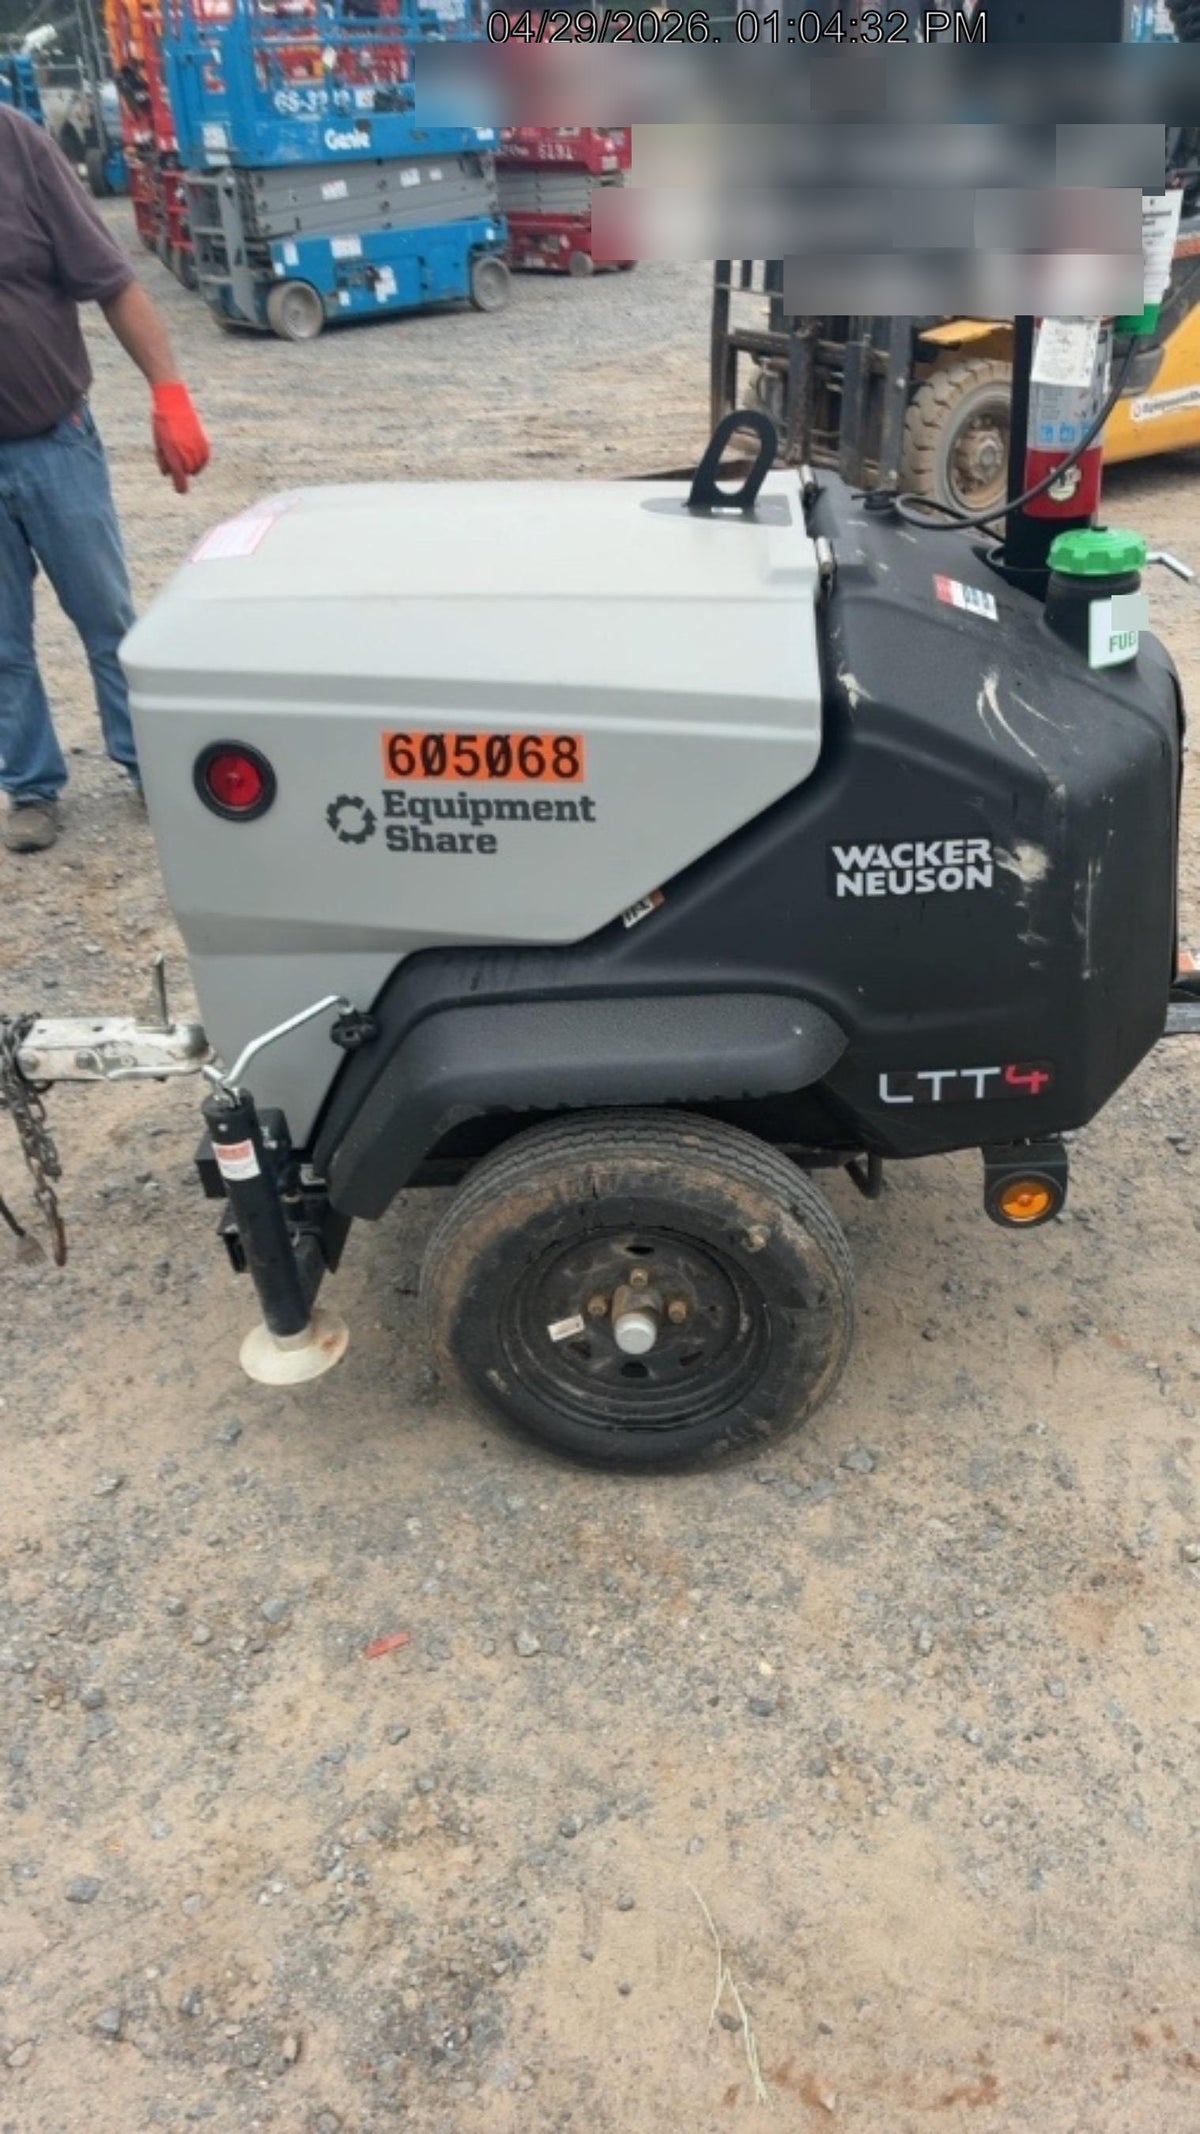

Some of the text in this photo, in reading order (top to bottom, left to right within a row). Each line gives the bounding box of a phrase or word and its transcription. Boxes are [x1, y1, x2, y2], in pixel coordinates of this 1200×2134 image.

[388, 734, 580, 778] 605068
[382, 790, 596, 826] Equipment
[385, 825, 498, 854] Share
[831, 839, 993, 871] WACKER
[836, 865, 993, 897] NEUSON
[879, 1064, 1049, 1103] LTT4
